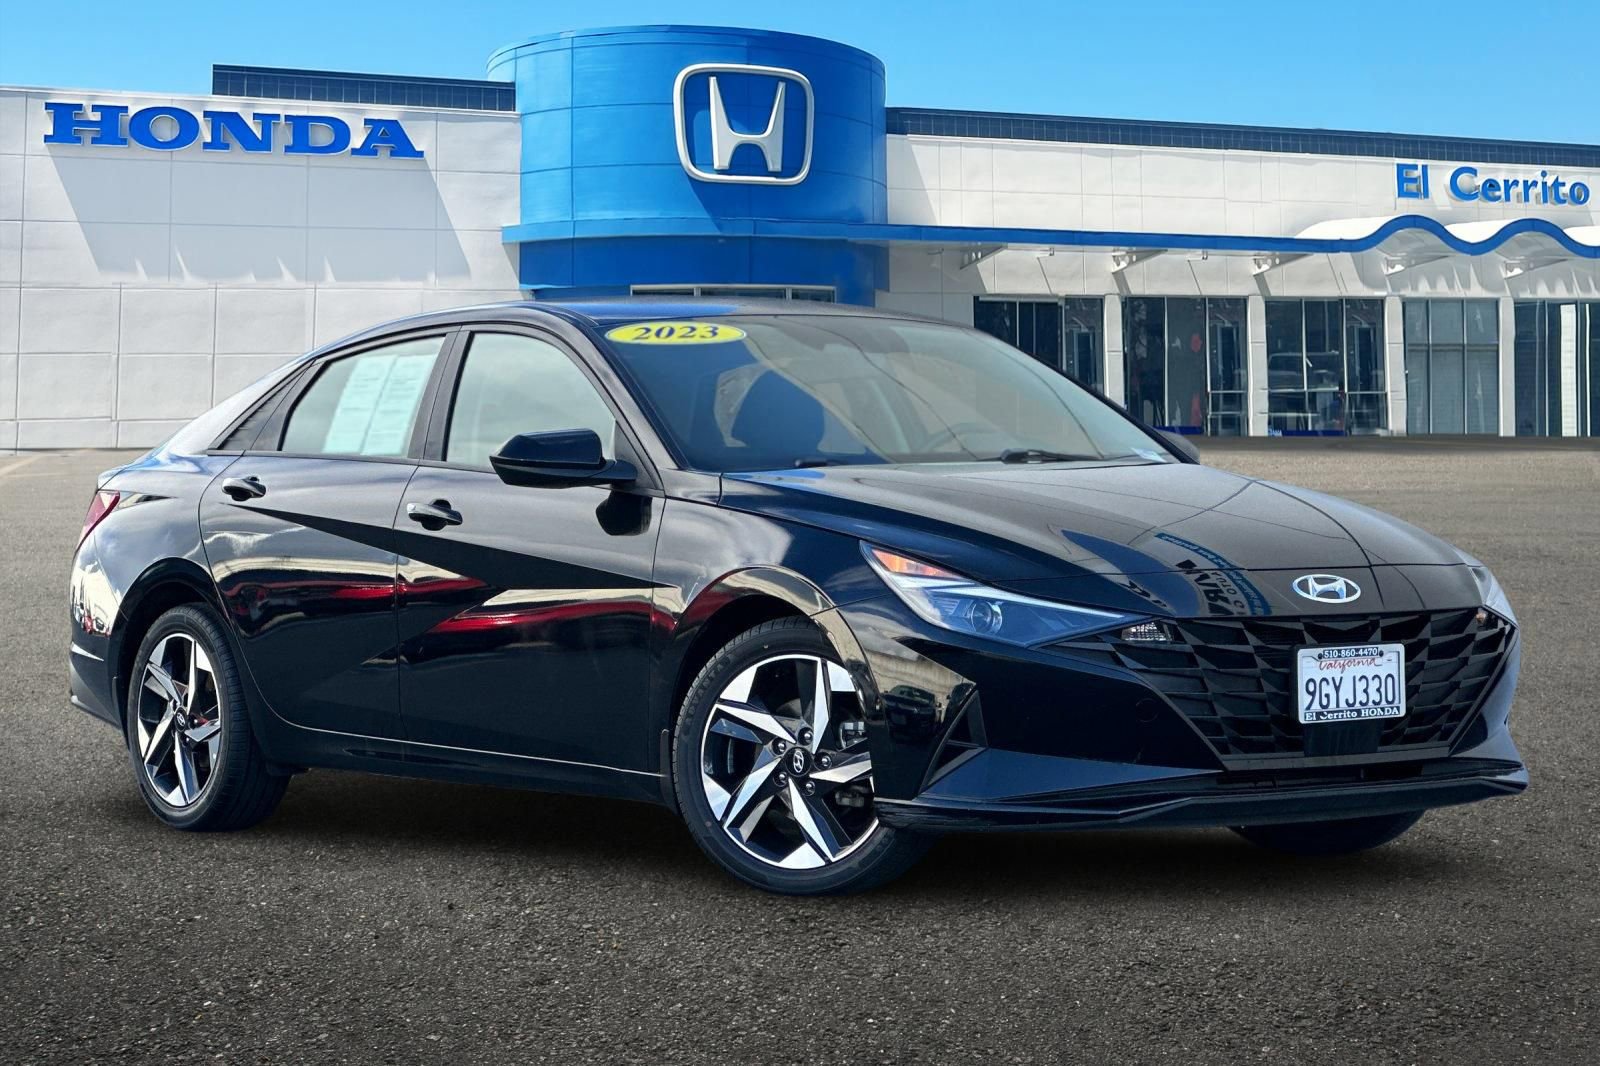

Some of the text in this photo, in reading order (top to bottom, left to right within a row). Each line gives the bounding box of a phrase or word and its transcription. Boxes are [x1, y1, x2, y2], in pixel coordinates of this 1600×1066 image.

[43, 101, 425, 158] HONDA
[1395, 162, 1591, 206] El Cerrito
[632, 325, 719, 341] 2023
[1324, 647, 1378, 658] 510-860-4470
[1319, 658, 1382, 674] California
[1305, 673, 1396, 711] 9GYJ330
[1306, 707, 1399, 720] El Cerrito HONDA
